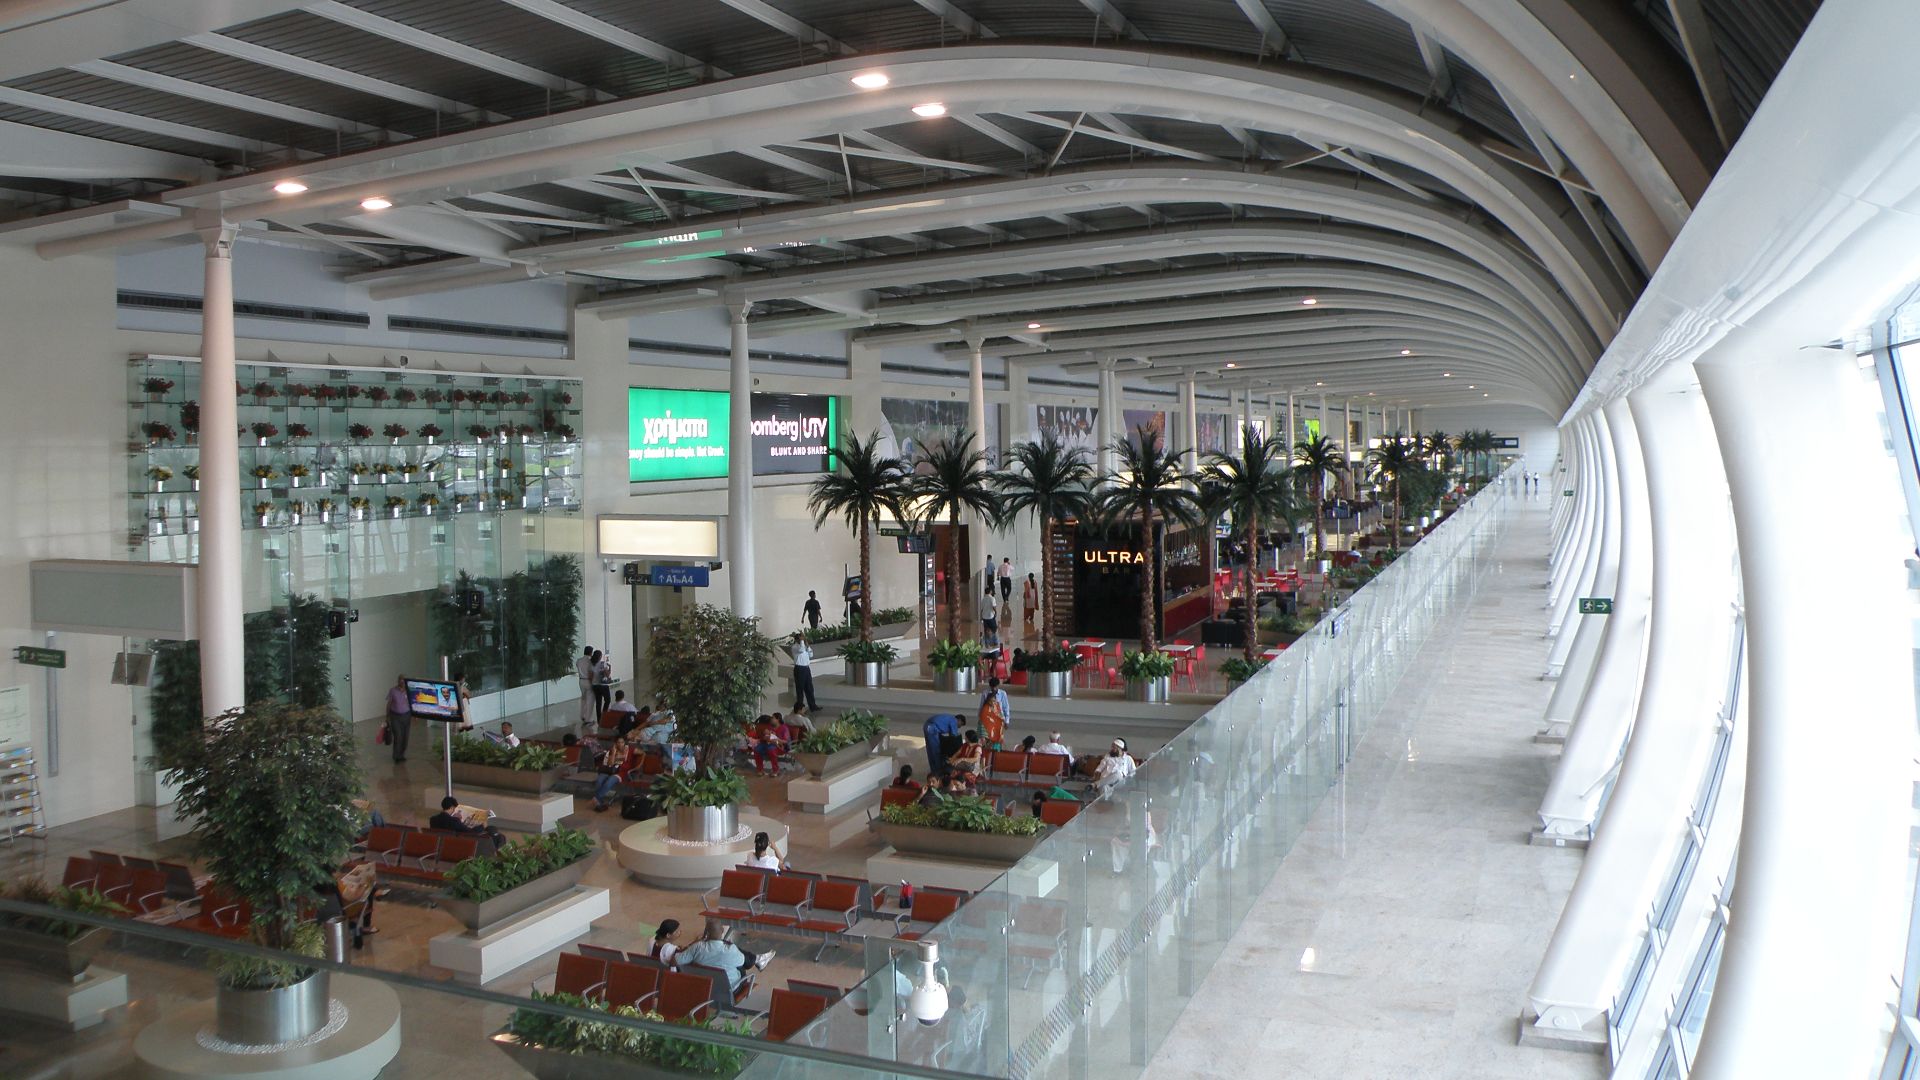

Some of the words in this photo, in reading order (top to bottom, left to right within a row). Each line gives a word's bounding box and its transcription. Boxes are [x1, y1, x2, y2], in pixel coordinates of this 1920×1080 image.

[802, 417, 828, 439] UTV
[792, 446, 806, 456] AND
[1084, 550, 1144, 564] ULTRA
